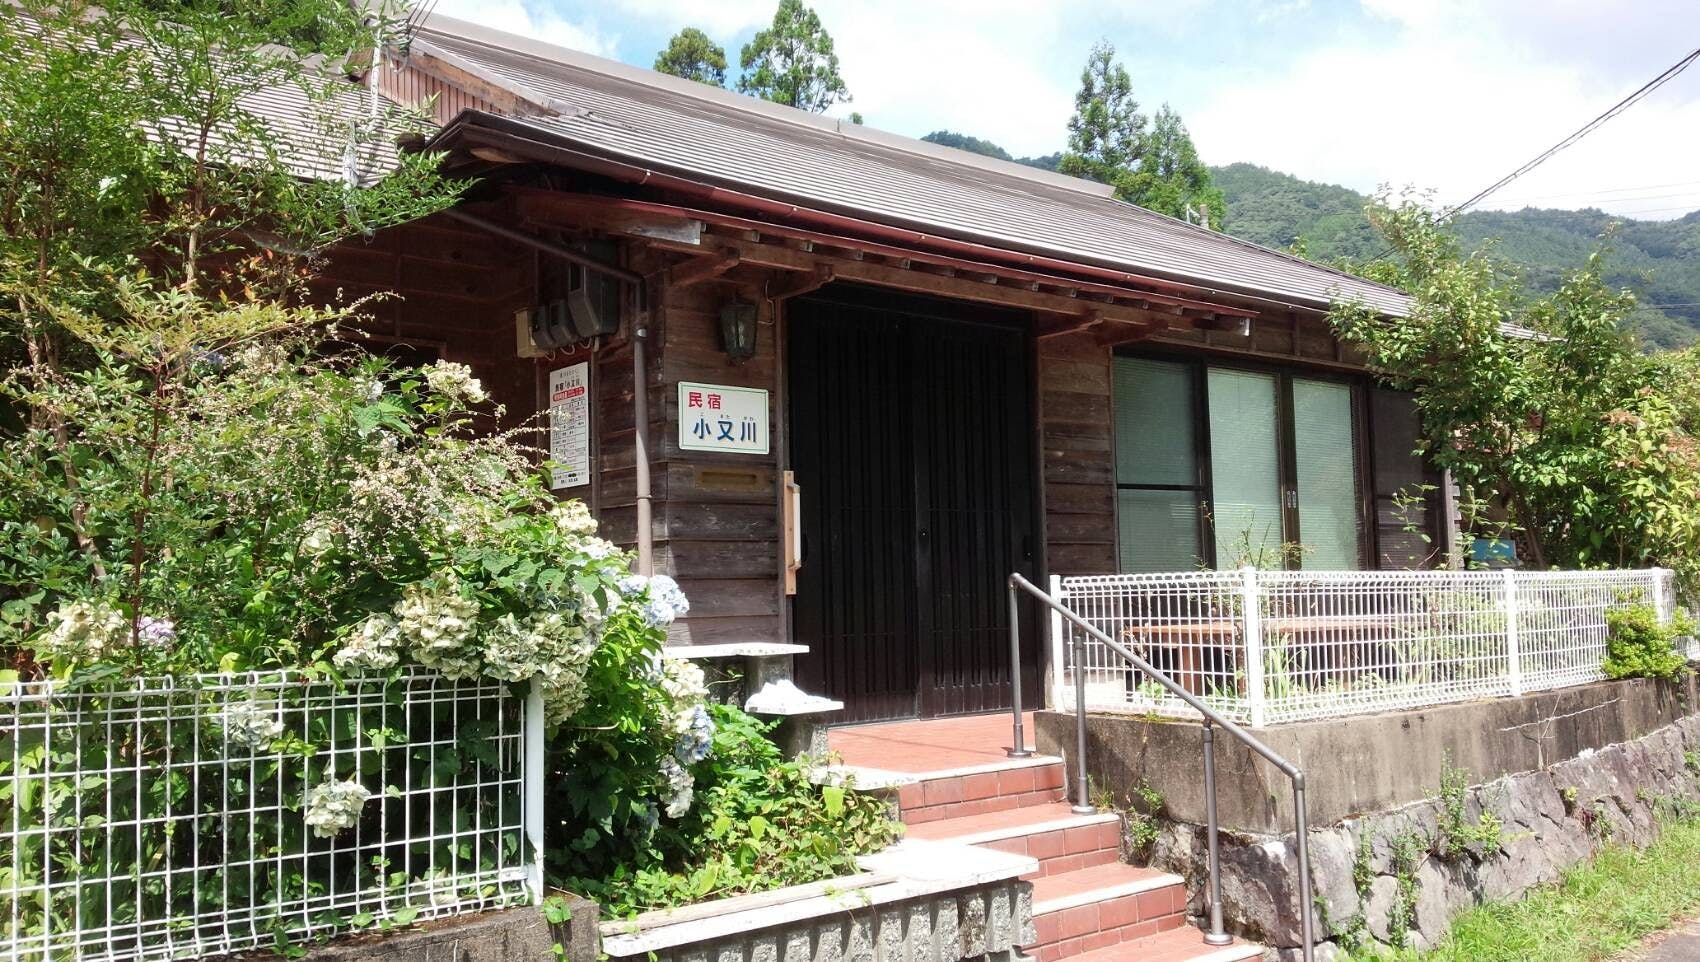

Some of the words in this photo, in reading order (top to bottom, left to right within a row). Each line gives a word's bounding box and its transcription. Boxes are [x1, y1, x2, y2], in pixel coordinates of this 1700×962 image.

[688, 391, 721, 410] 民宿
[693, 418, 756, 443] 小又川
